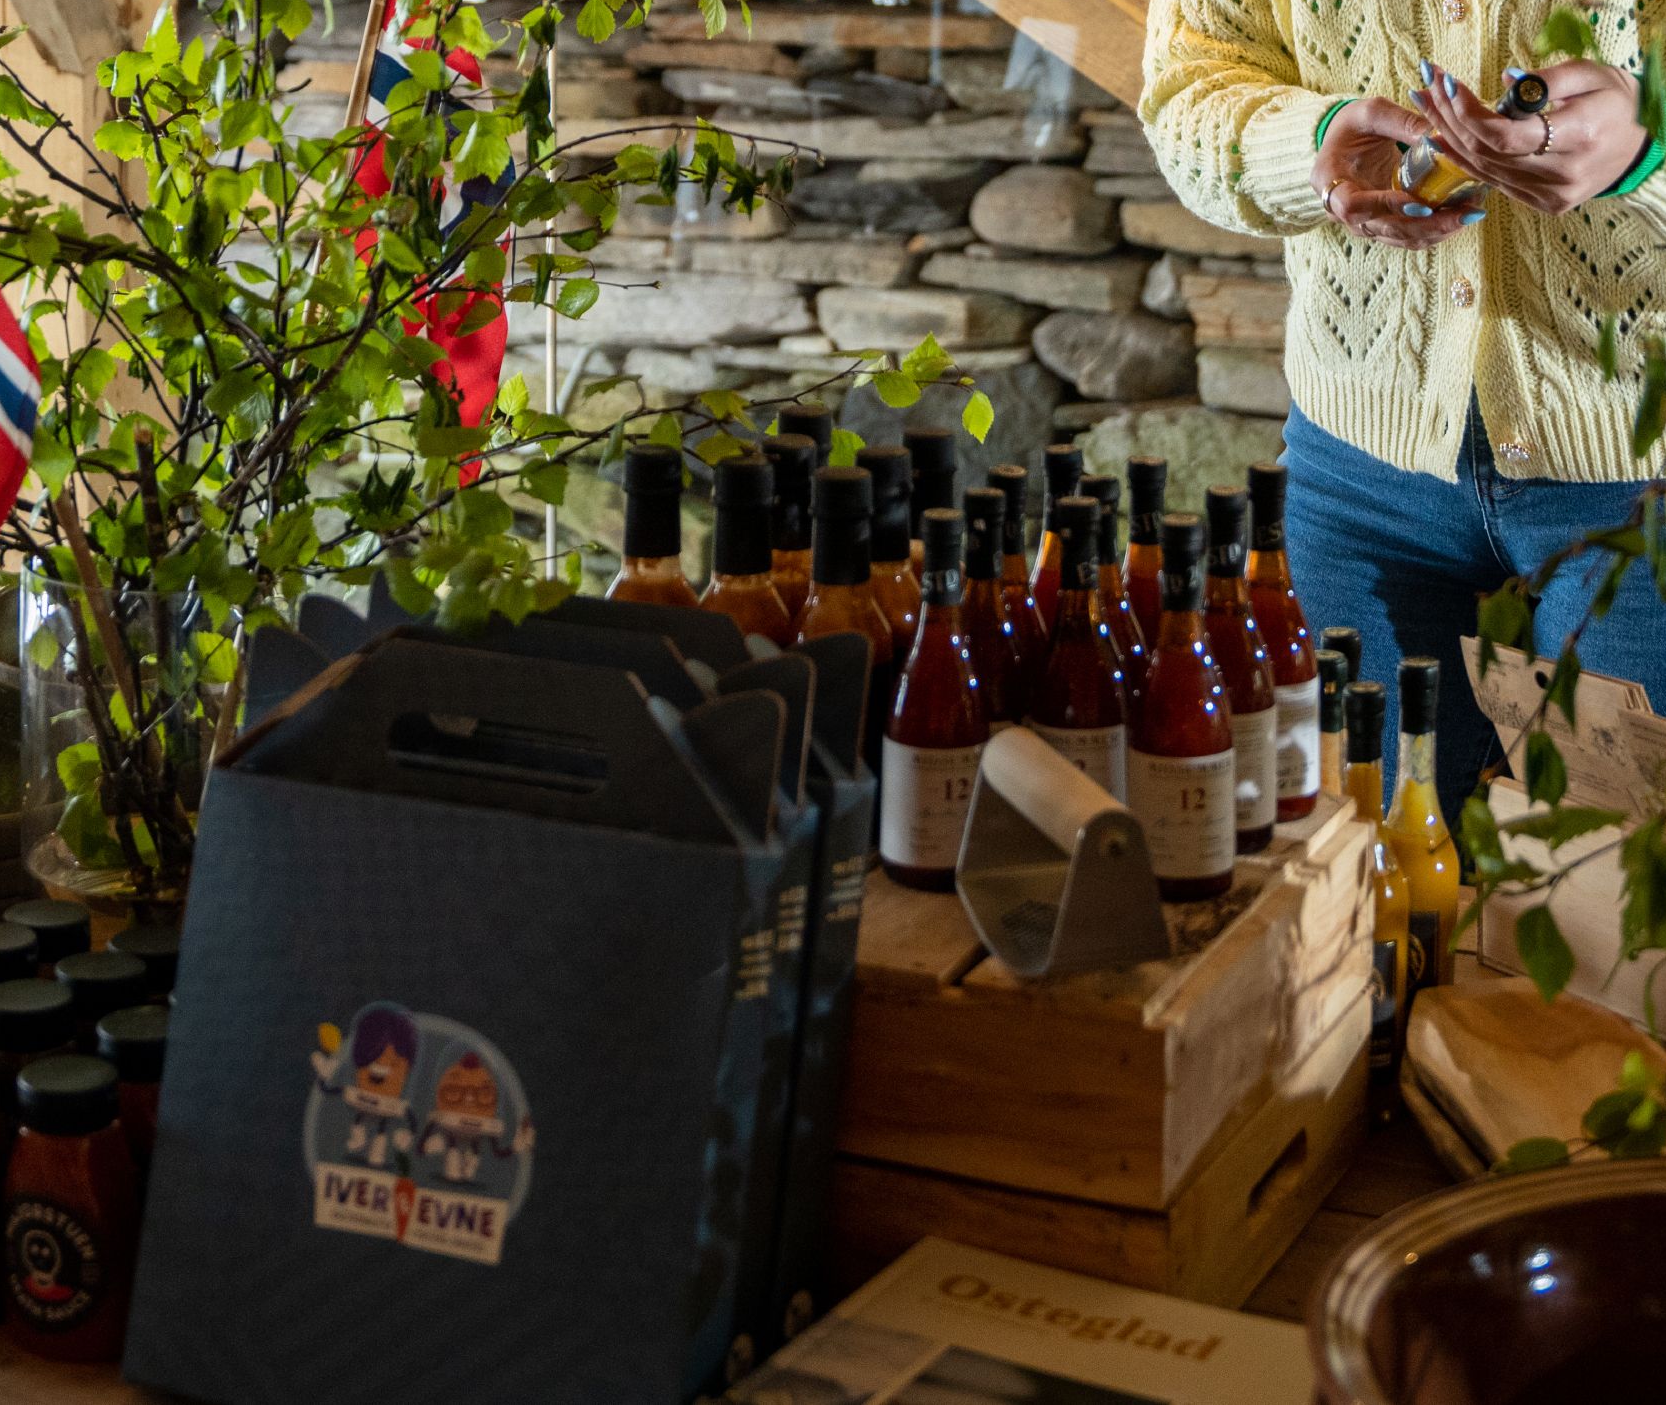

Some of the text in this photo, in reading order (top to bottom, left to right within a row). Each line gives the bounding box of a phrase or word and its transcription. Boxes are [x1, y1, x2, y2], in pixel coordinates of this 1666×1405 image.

[944, 777, 970, 802] 12
[1180, 787, 1206, 810] 12
[325, 1171, 390, 1213] IVER
[418, 1195, 495, 1237] EVNE
[938, 1272, 1223, 1362] Osteglad
